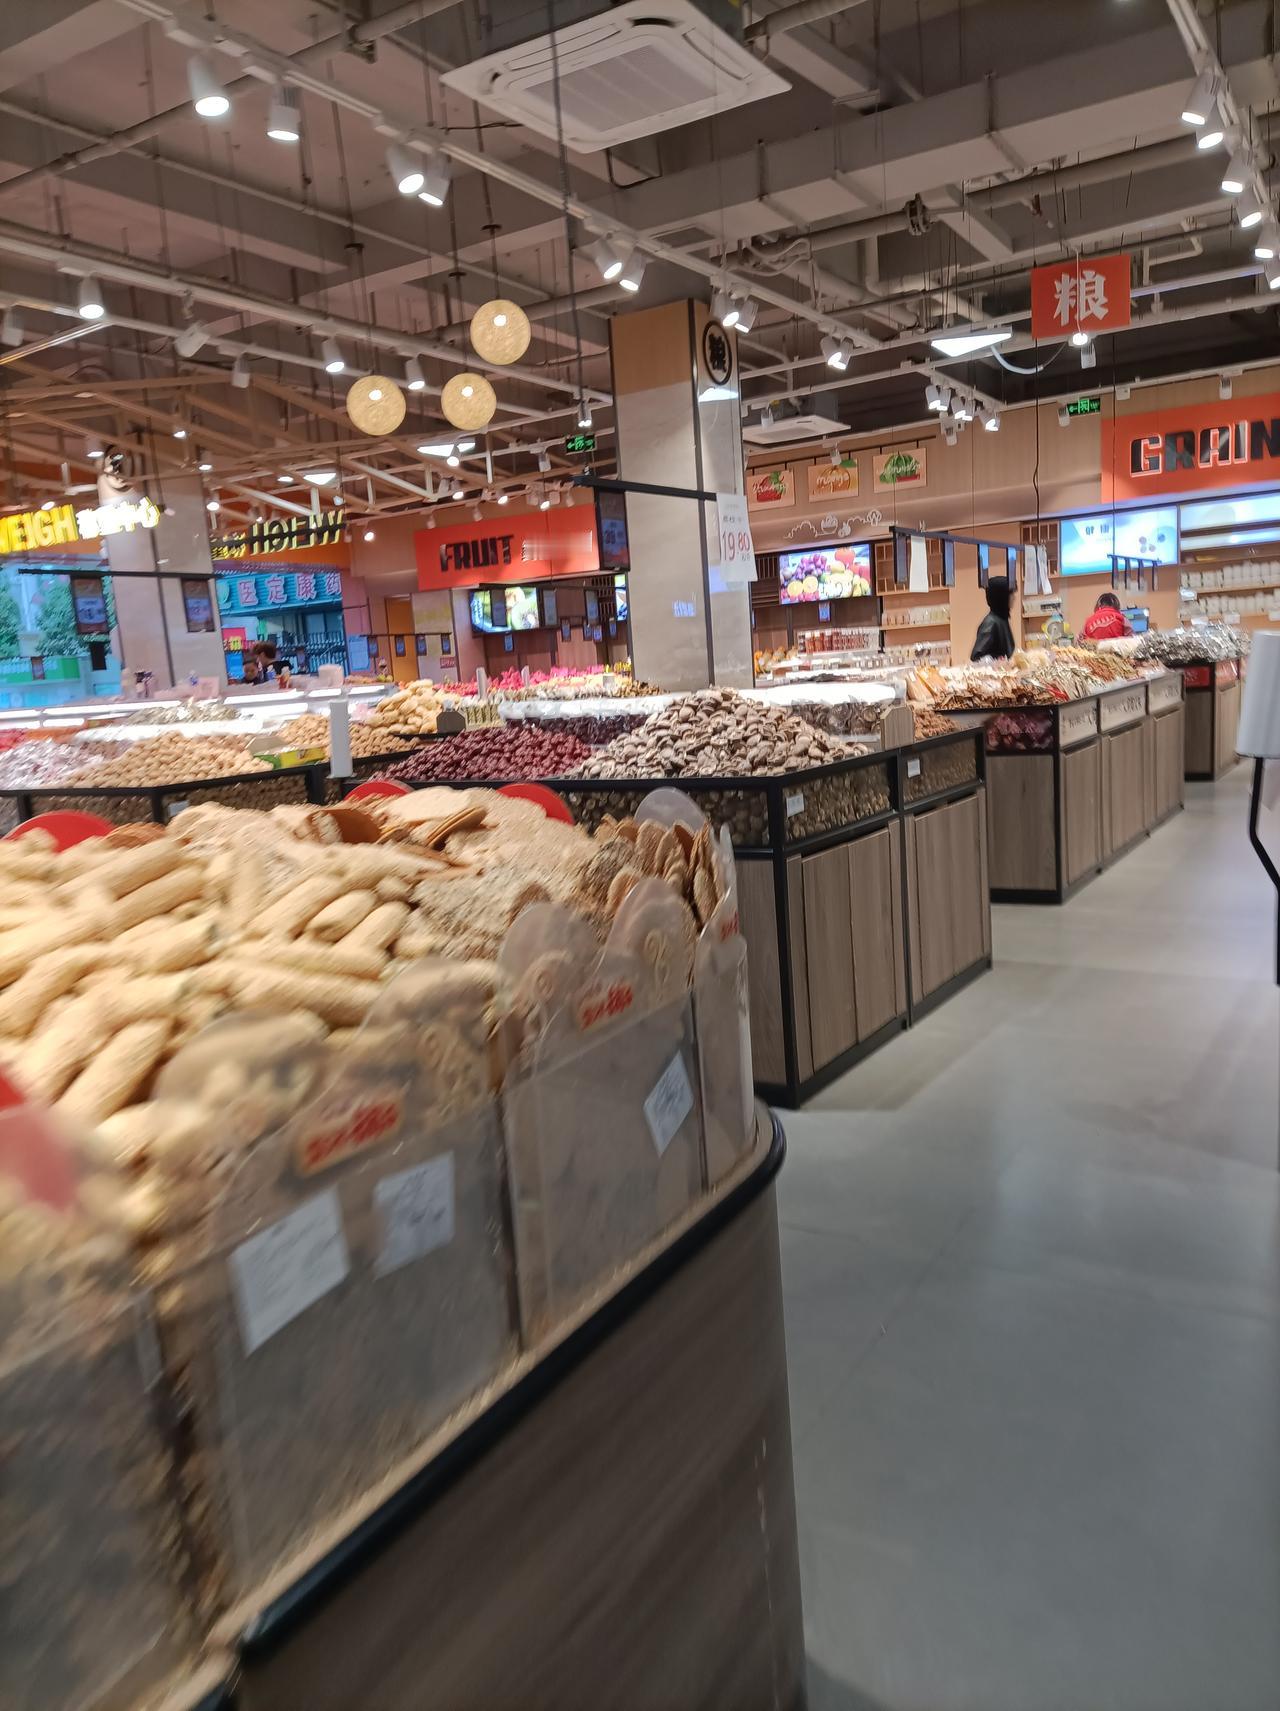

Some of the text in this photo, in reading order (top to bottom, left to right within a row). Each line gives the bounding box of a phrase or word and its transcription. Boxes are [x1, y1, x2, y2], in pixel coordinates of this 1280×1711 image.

[1053, 270, 1110, 327] 粮
[1129, 419, 1280, 478] GRAIN
[440, 534, 514, 572] FRUIT
